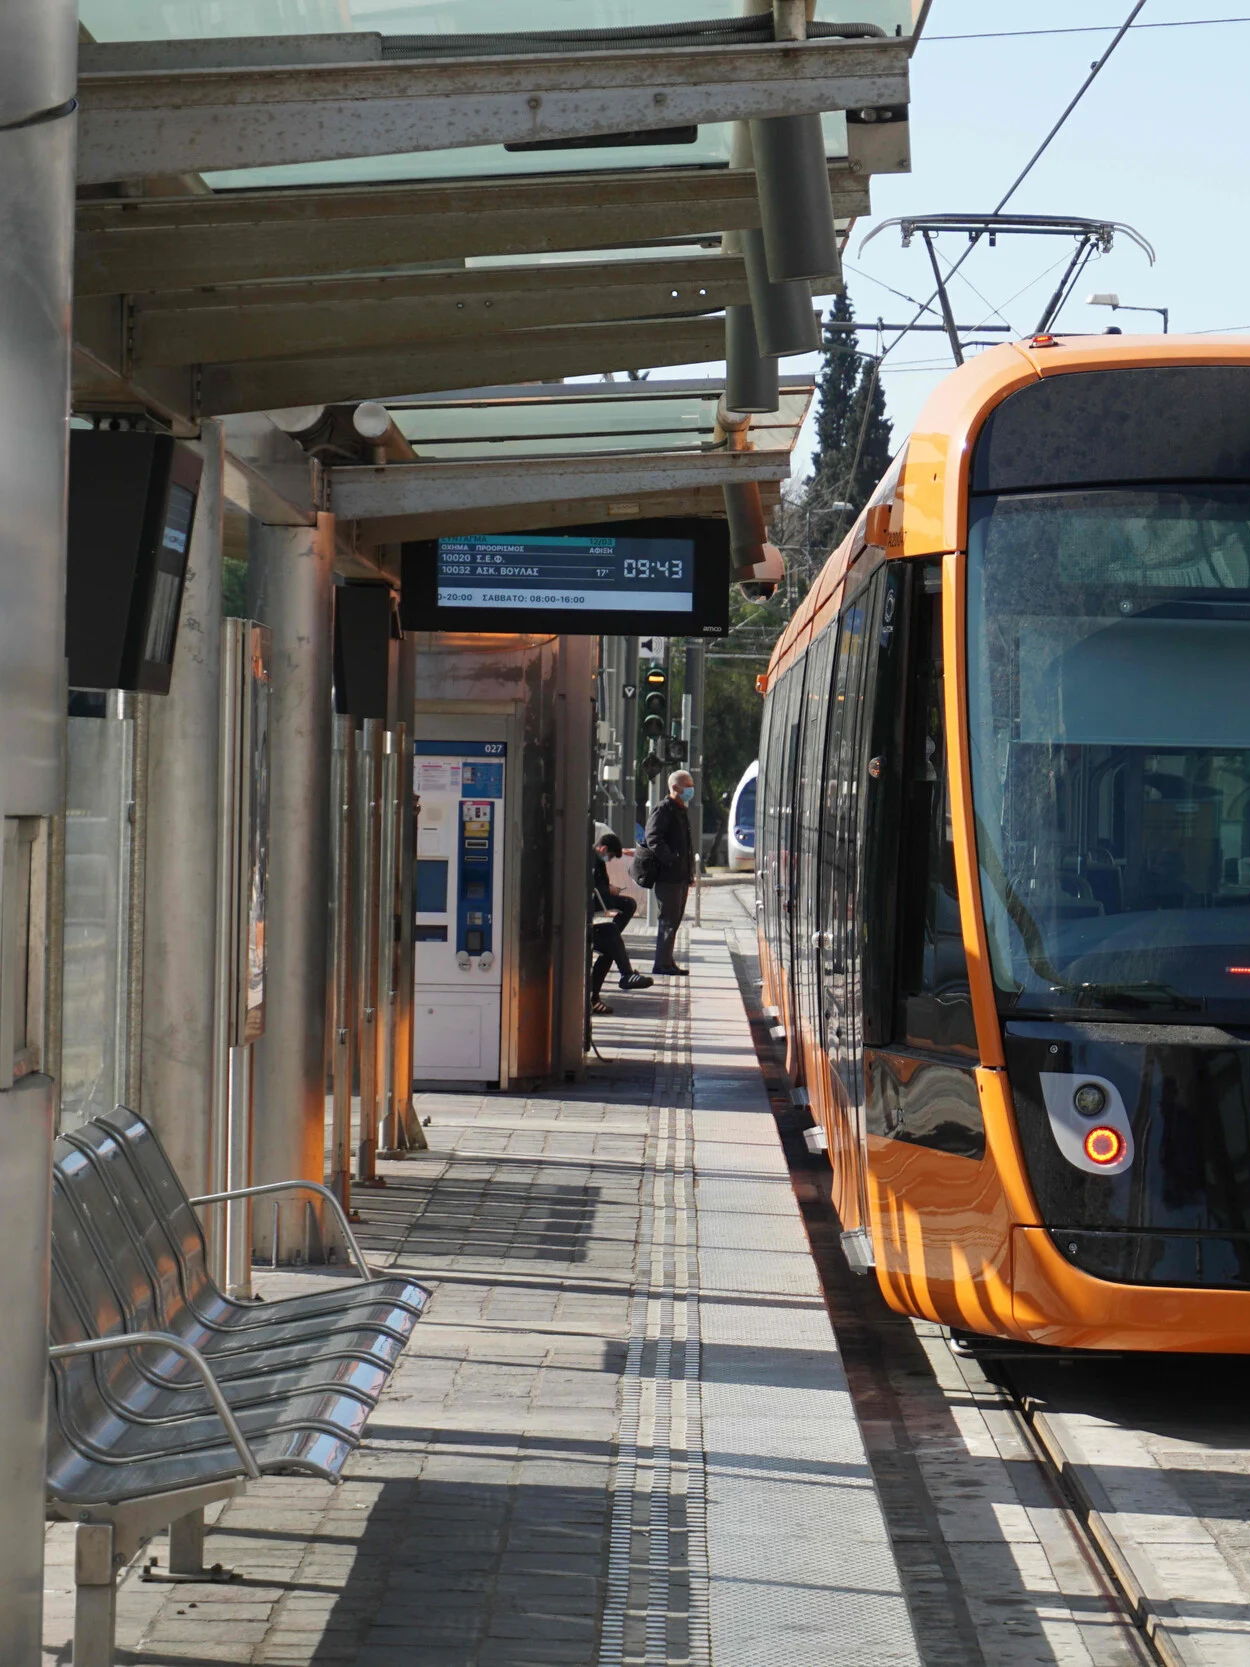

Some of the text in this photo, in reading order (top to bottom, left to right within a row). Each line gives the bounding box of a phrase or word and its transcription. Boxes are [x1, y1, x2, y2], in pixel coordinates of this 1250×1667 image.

[442, 553, 505, 563] 10020 Σ.Ε.Φ.
[442, 565, 471, 574] 10032
[476, 566, 498, 575] ΑΣΚ.
[500, 567, 539, 576] ΒΟΥΛΑΣ
[624, 559, 683, 579] 09:43
[482, 594, 528, 603] ΣΑΒΒΑΤΟ:
[530, 595, 585, 604] 08:00-16:00
[485, 744, 503, 753] 027
